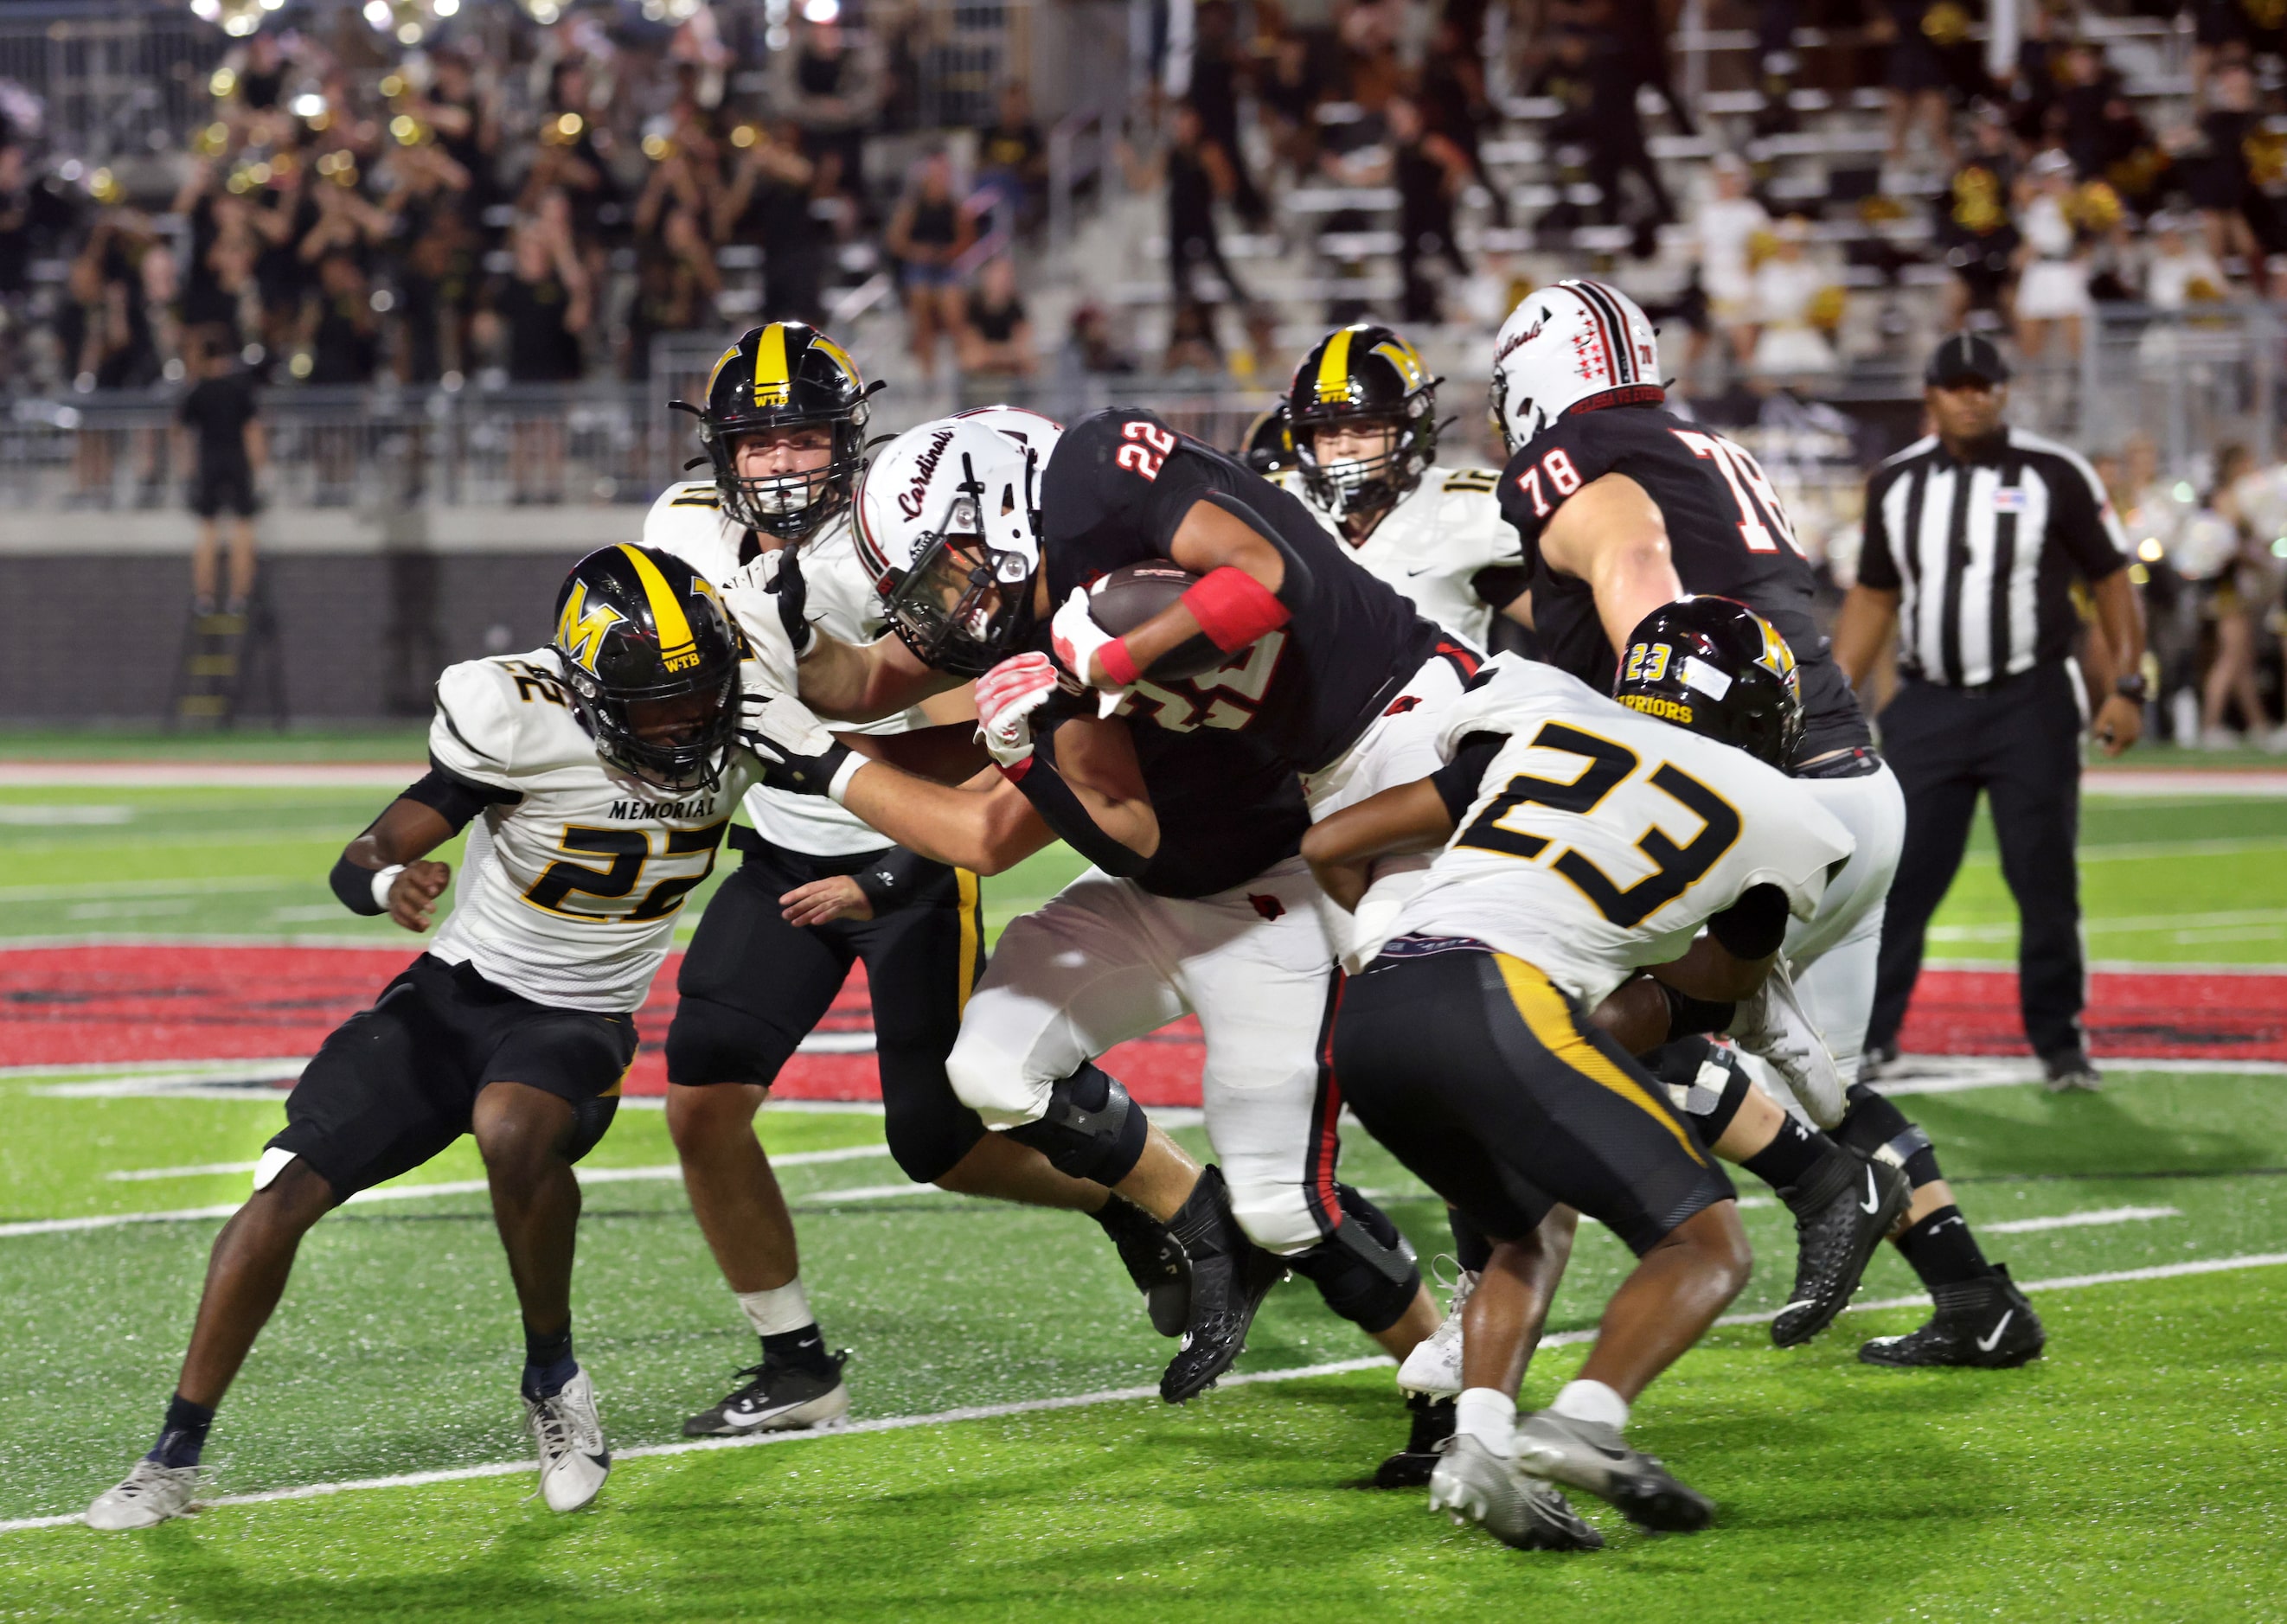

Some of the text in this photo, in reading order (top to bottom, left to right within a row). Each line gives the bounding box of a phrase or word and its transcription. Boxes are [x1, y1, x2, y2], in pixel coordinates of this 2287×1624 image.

[753, 393, 790, 408] WTB
[898, 430, 955, 523] Cardinals
[1116, 421, 1177, 483] 22
[1517, 447, 1584, 518] 78
[1669, 427, 1807, 560] 78
[555, 578, 630, 681] M
[663, 652, 701, 674] WTB
[1625, 643, 1672, 681] 23
[608, 797, 716, 820] MEMORIAL
[1453, 719, 1744, 931] 23
[520, 816, 730, 924] 22
